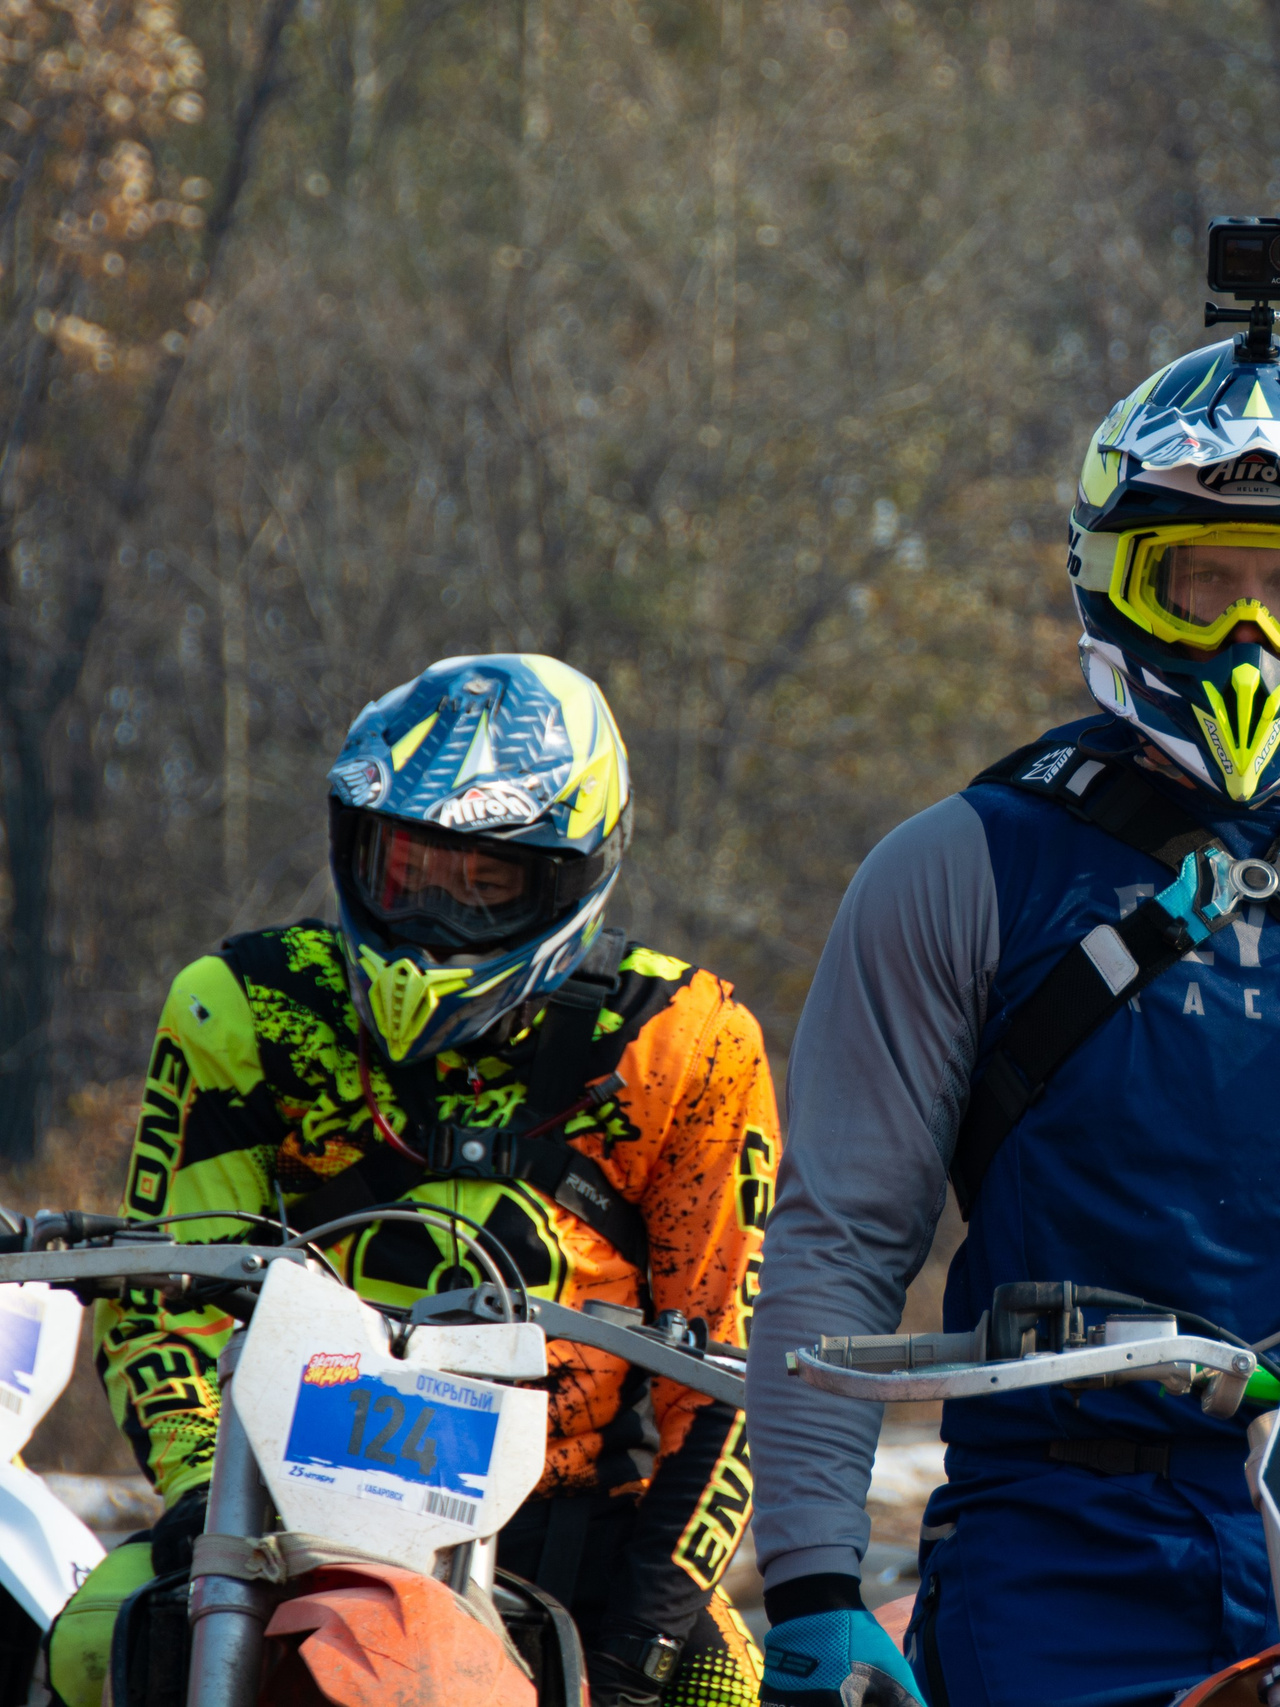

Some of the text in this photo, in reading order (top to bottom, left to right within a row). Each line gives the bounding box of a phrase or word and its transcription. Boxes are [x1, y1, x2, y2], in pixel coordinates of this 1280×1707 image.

[1203, 718, 1233, 775] Airoh
[439, 789, 531, 828] Airoh
[416, 1374, 494, 1411] ОТКРЫТЫЙ
[347, 1388, 437, 1476] 124
[288, 1465, 304, 1477] 25
